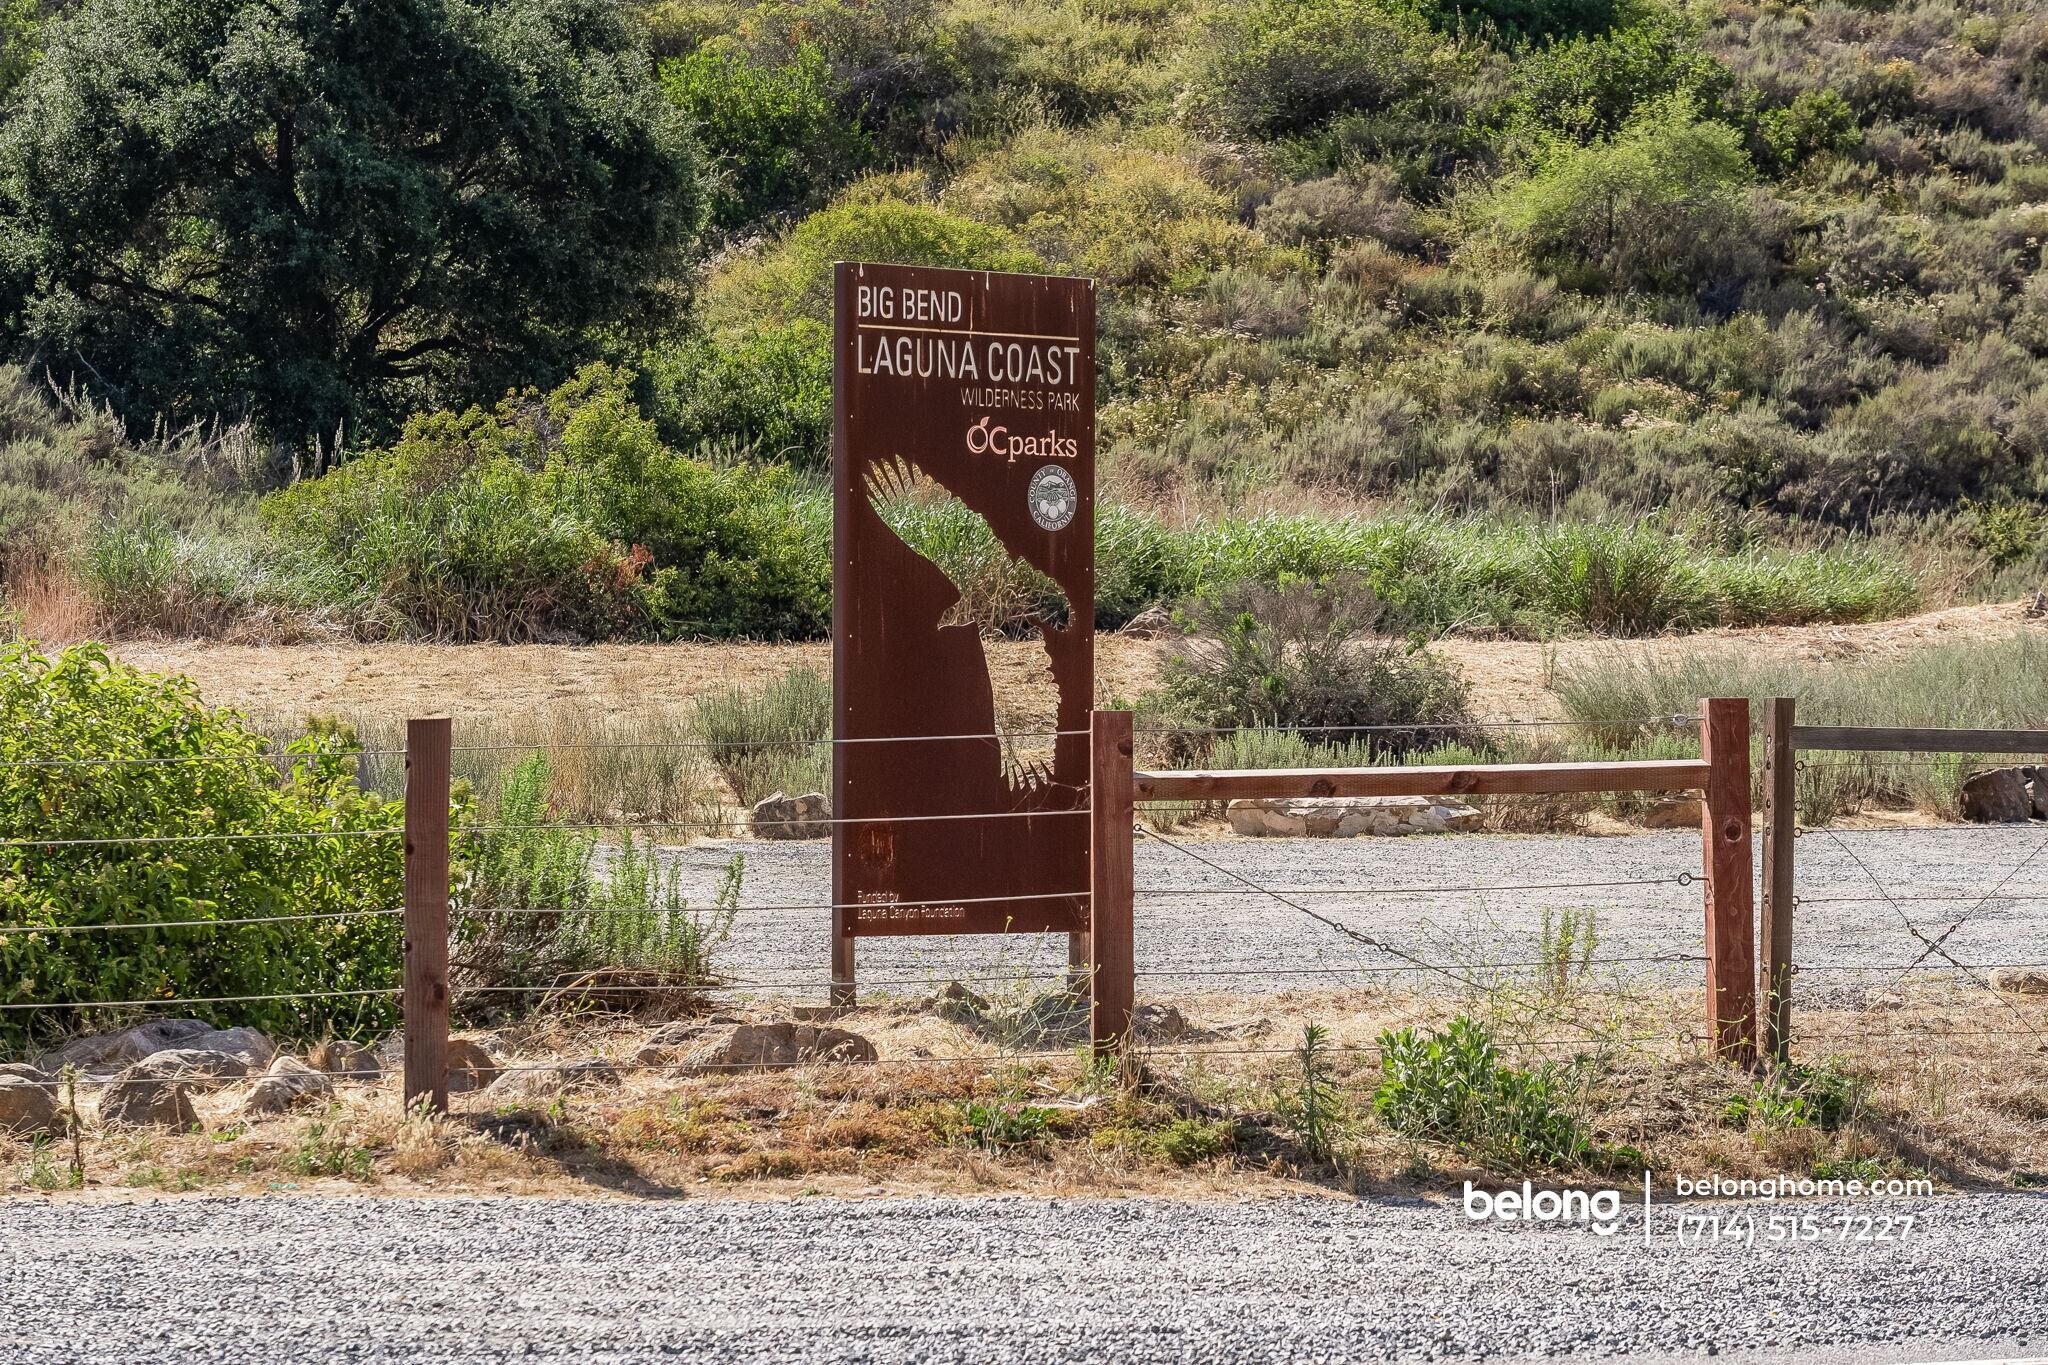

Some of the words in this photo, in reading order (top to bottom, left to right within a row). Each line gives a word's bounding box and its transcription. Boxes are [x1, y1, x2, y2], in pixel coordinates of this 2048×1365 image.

[858, 285, 894, 319] BIG
[902, 288, 962, 322] BEND
[858, 334, 979, 380] LAGUNA
[988, 342, 1080, 385] COAST
[960, 387, 1043, 410] WILDERNESS
[1048, 392, 1080, 412] PARK
[1033, 510, 1074, 530] CALIFORNIA
[858, 890, 887, 904] Funded
[889, 890, 899, 904] by
[858, 906, 887, 921] Laguna
[889, 905, 919, 920] Canyon
[921, 904, 966, 918] Foundation
